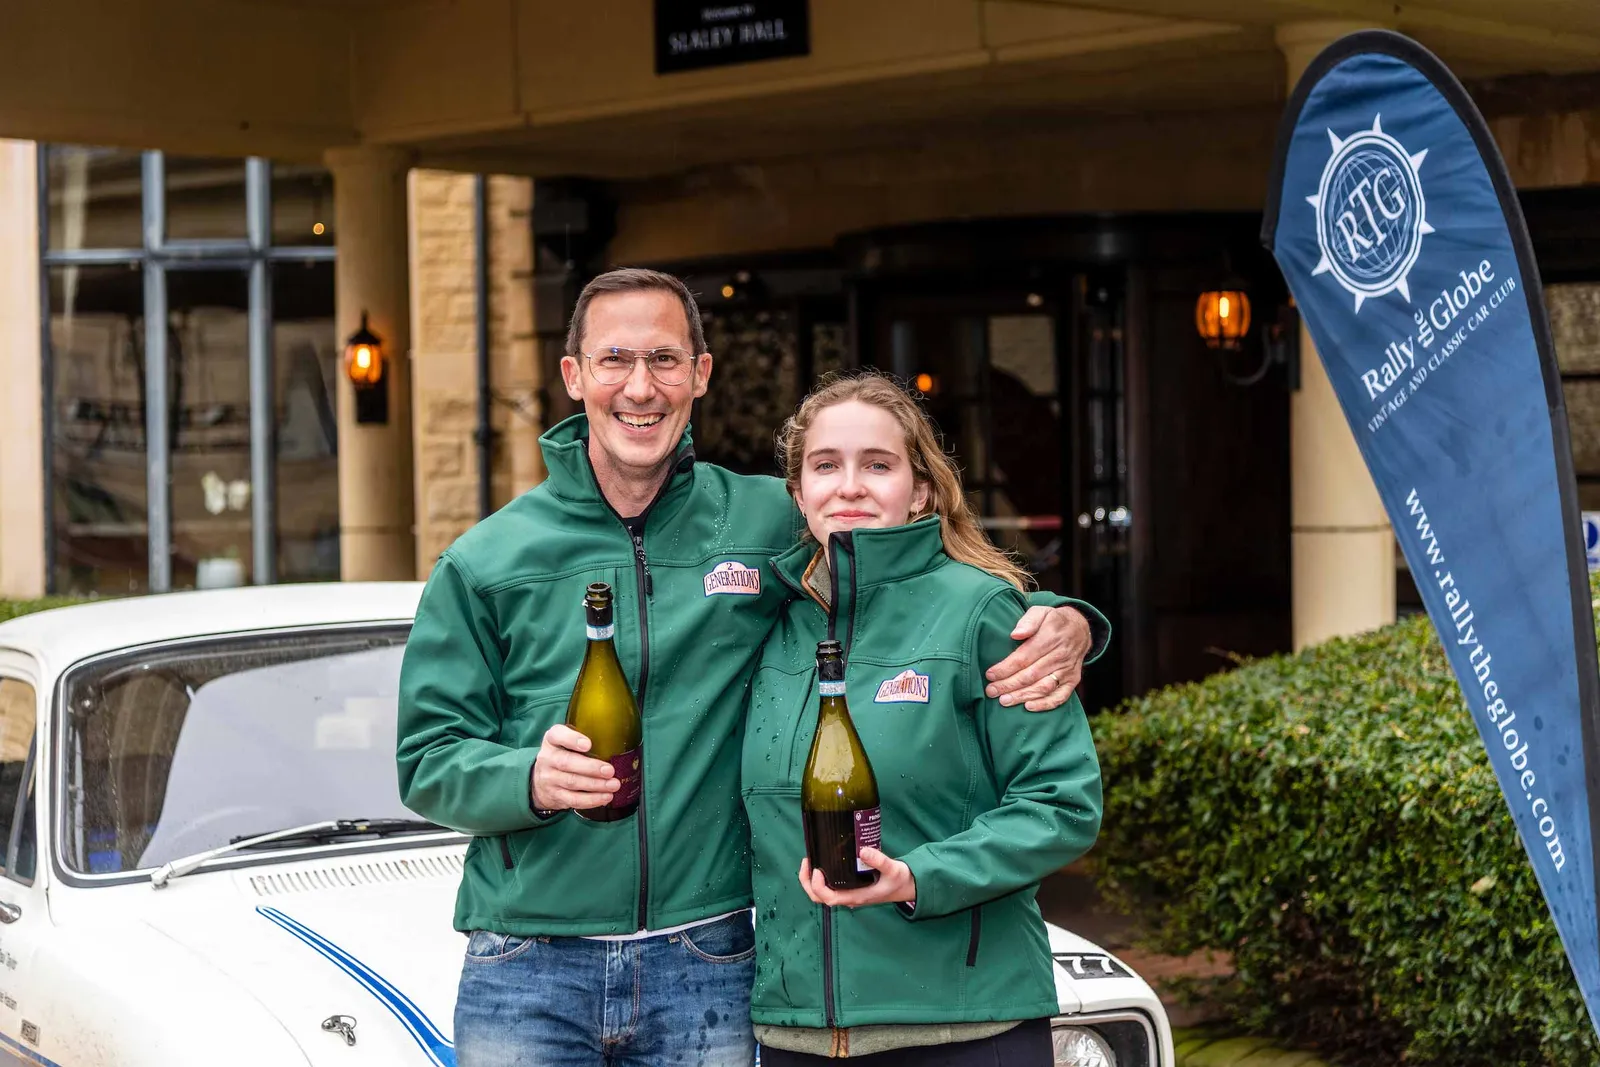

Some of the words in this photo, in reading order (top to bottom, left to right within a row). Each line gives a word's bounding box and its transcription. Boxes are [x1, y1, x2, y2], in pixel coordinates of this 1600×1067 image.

[737, 17, 787, 44] HALL
[1335, 167, 1406, 264] RTG
[1361, 335, 1415, 402] Rally
[1414, 308, 1435, 349] the
[1429, 259, 1495, 331] Globe
[1367, 388, 1408, 433] VINTAGE
[1408, 366, 1428, 395] AND
[1428, 325, 1468, 371] CLASSIC
[1467, 304, 1490, 331] CAR
[1489, 276, 1516, 309] CLUB
[705, 570, 759, 592] GENERATIONS
[726, 562, 734, 571] 2
[878, 676, 928, 699] GENERATIONS
[1405, 487, 1567, 874] www.rallytheglobe.com
